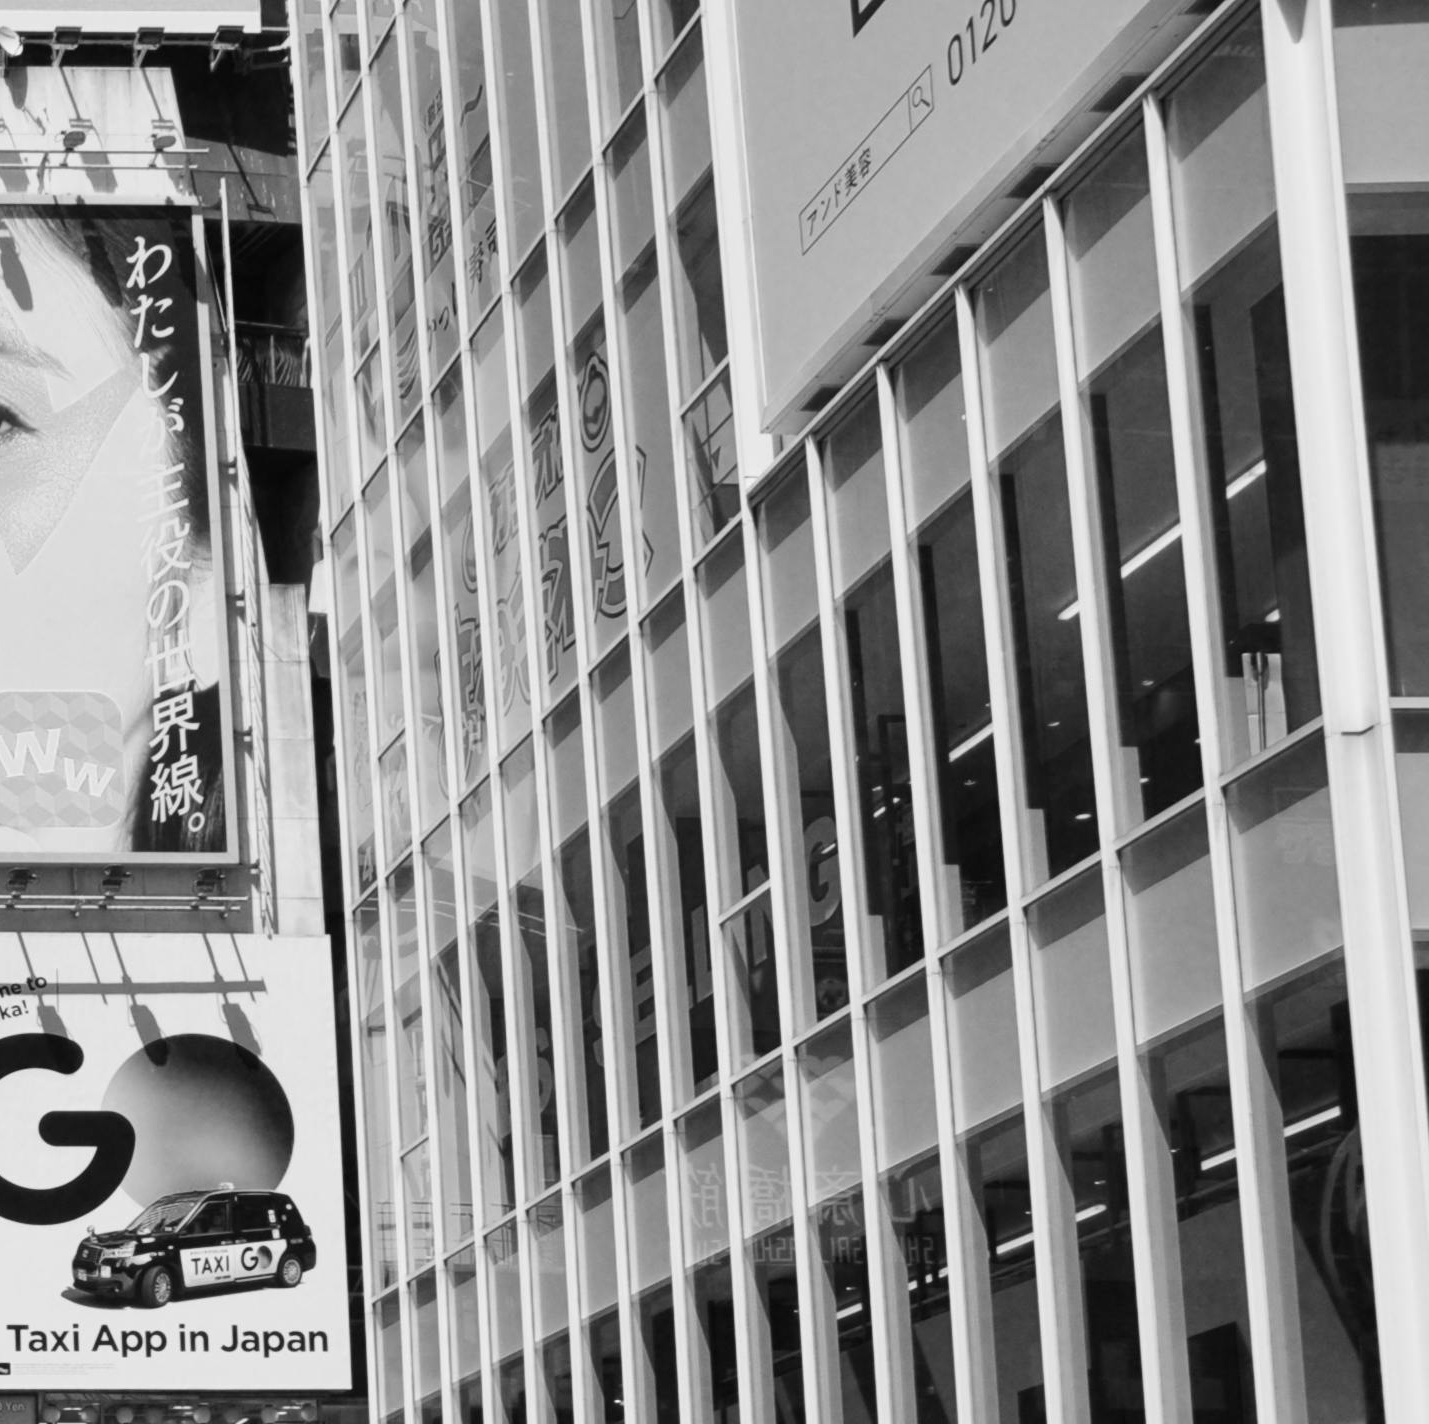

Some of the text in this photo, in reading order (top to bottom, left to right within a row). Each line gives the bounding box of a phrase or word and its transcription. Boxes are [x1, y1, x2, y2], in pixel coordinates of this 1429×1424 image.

[25, 975, 48, 994] to
[192, 1245, 273, 1276] TAXI GO
[7, 1323, 80, 1353] Taxi
[91, 1323, 168, 1358] App
[179, 1323, 210, 1353] in
[220, 1323, 330, 1358] Japan
[5, 1402, 25, 1411] Yen
